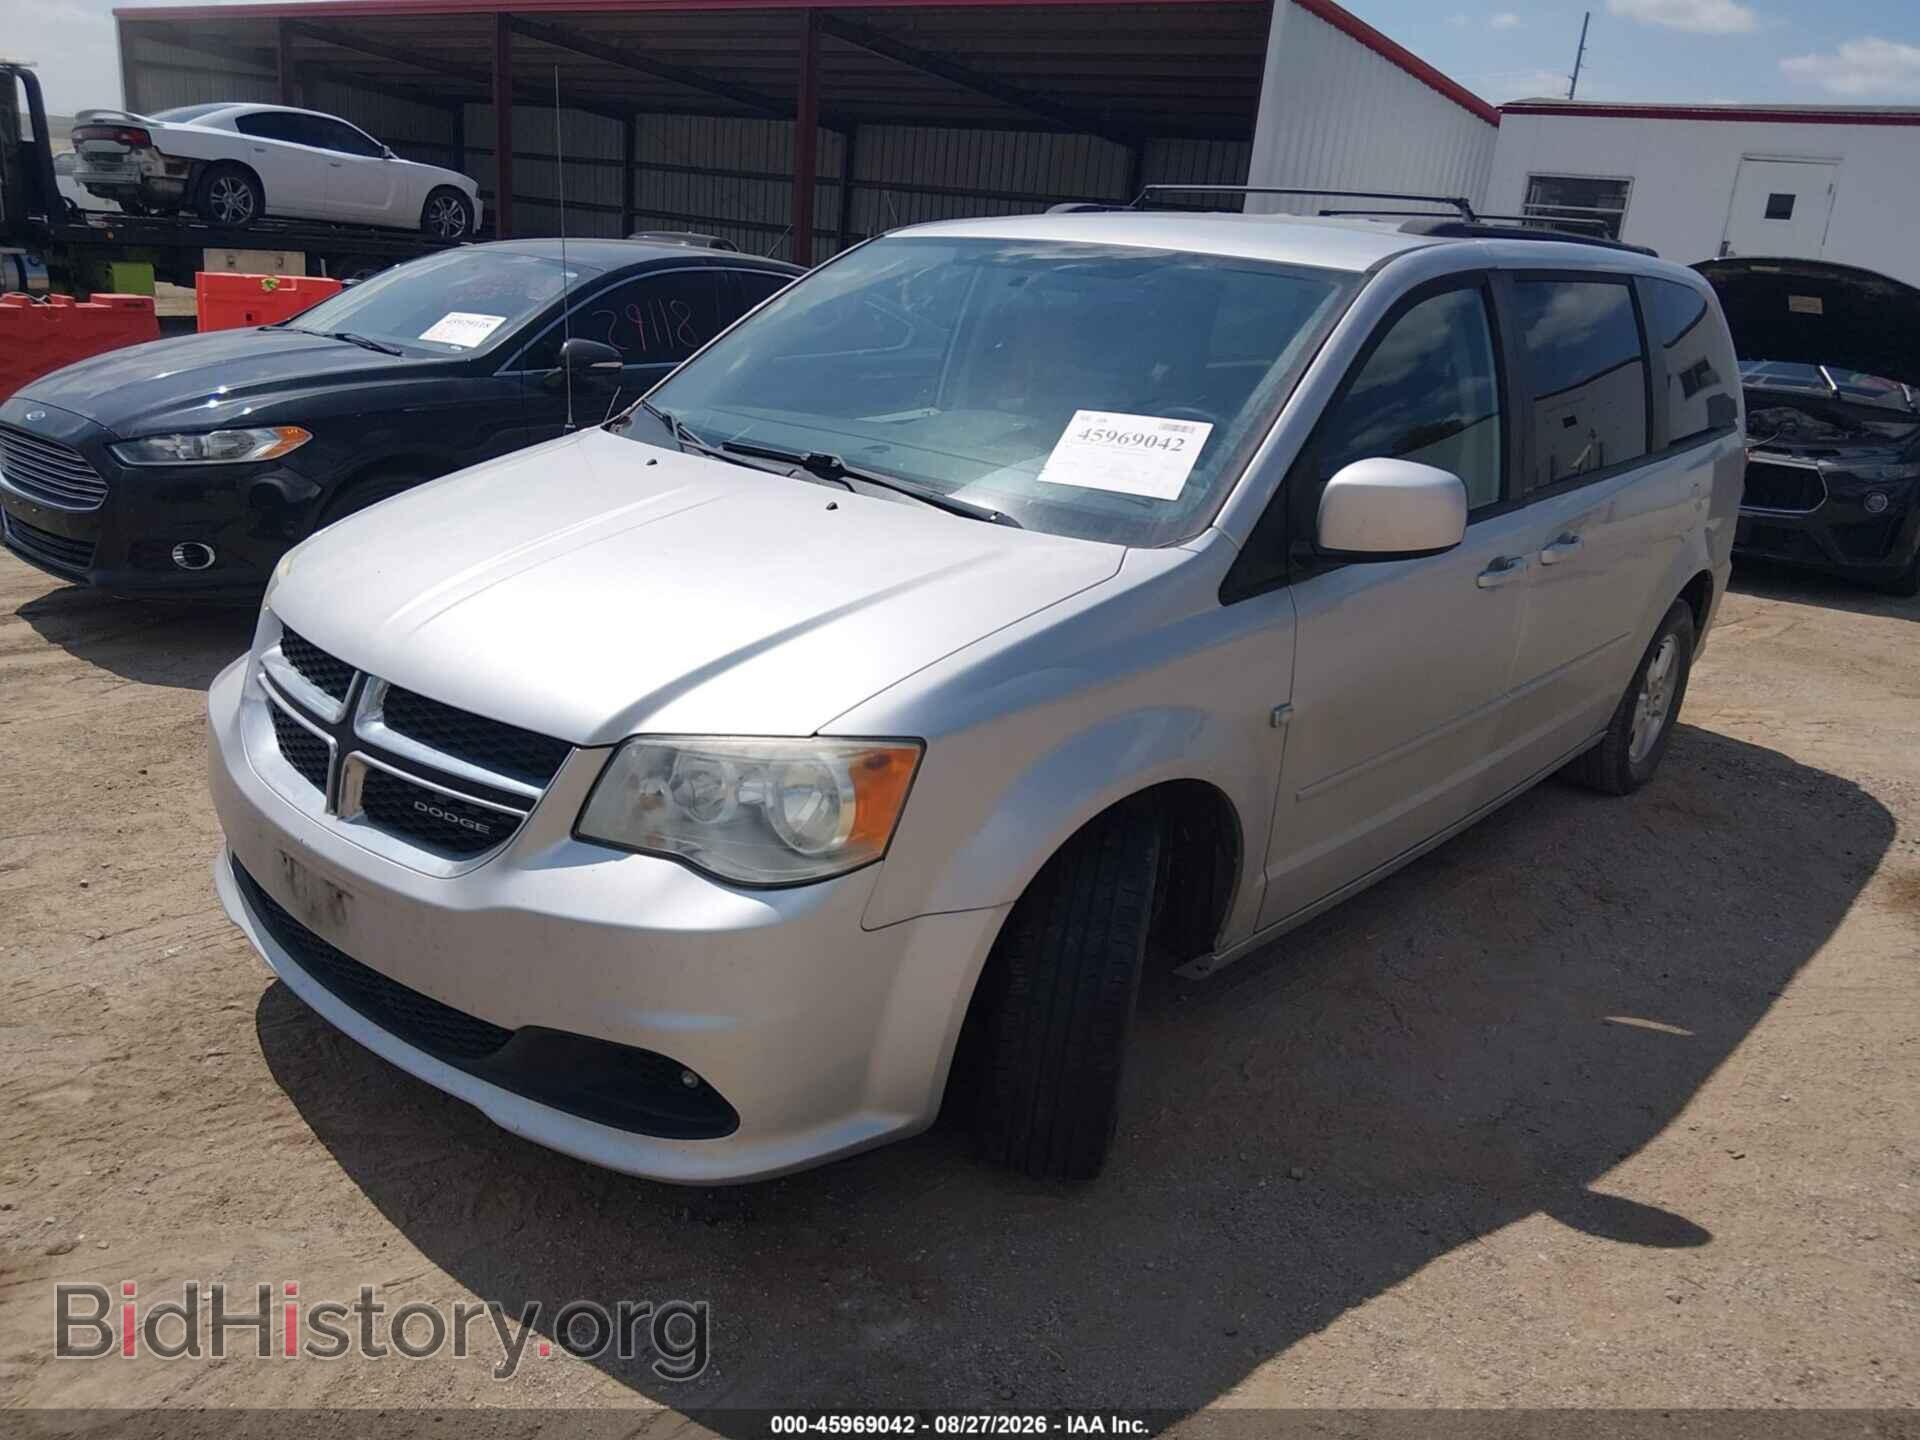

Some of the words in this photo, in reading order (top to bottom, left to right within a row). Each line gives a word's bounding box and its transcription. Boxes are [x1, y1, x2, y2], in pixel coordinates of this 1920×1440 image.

[591, 298, 699, 350] 29118
[1078, 427, 1185, 452] 45969042
[414, 801, 490, 834] DODGE
